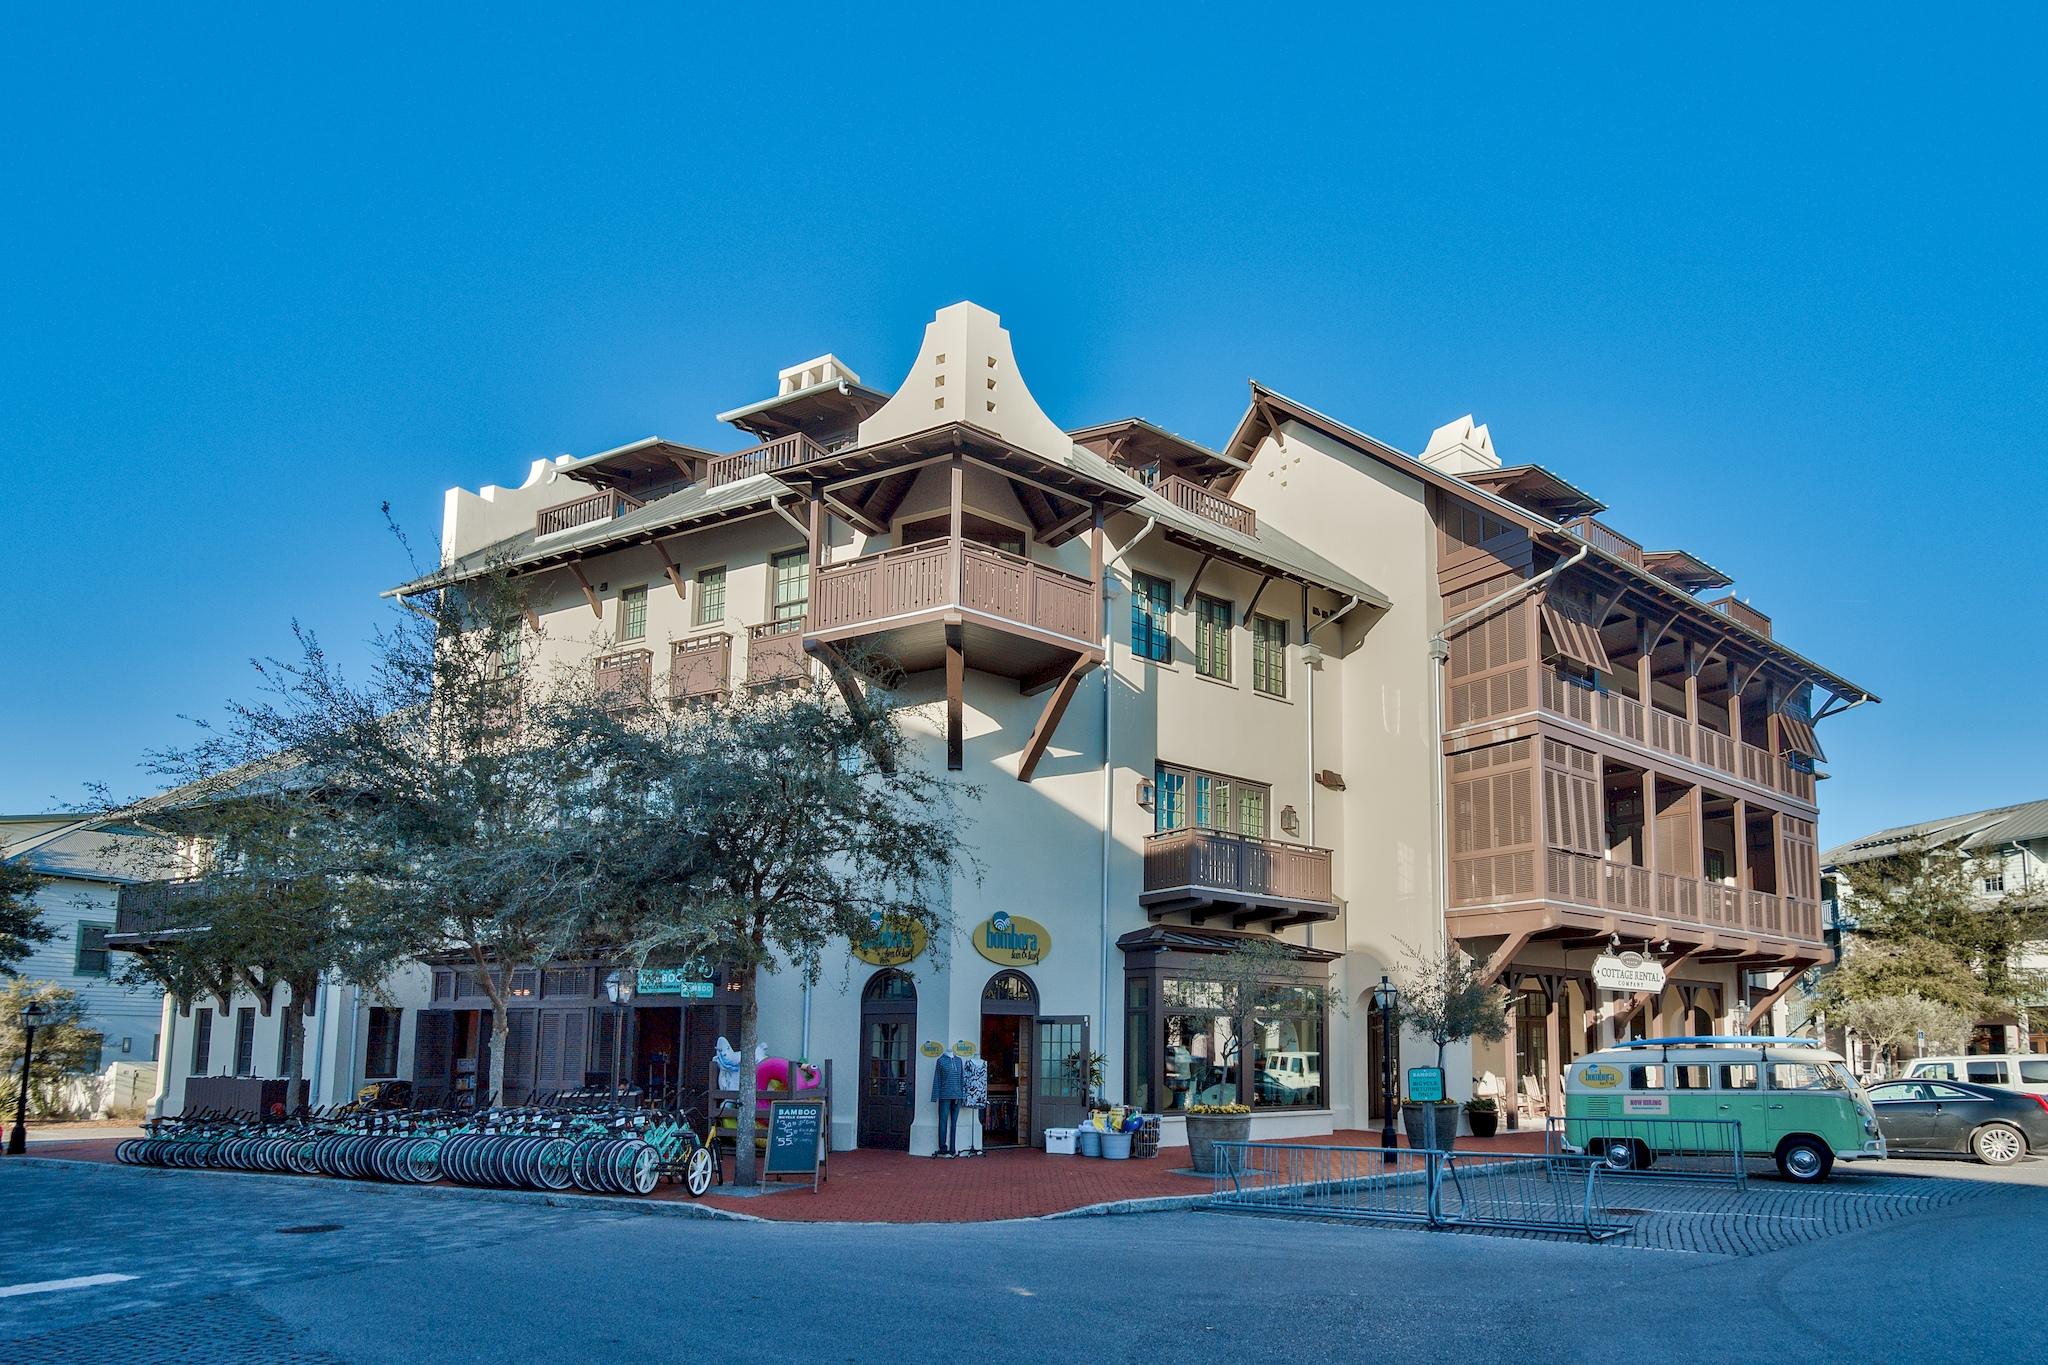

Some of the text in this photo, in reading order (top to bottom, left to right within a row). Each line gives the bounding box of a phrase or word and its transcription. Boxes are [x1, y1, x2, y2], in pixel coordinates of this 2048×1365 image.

[986, 921, 1037, 951] bombora
[1601, 967, 1660, 982] COTTAGE RENTAL
